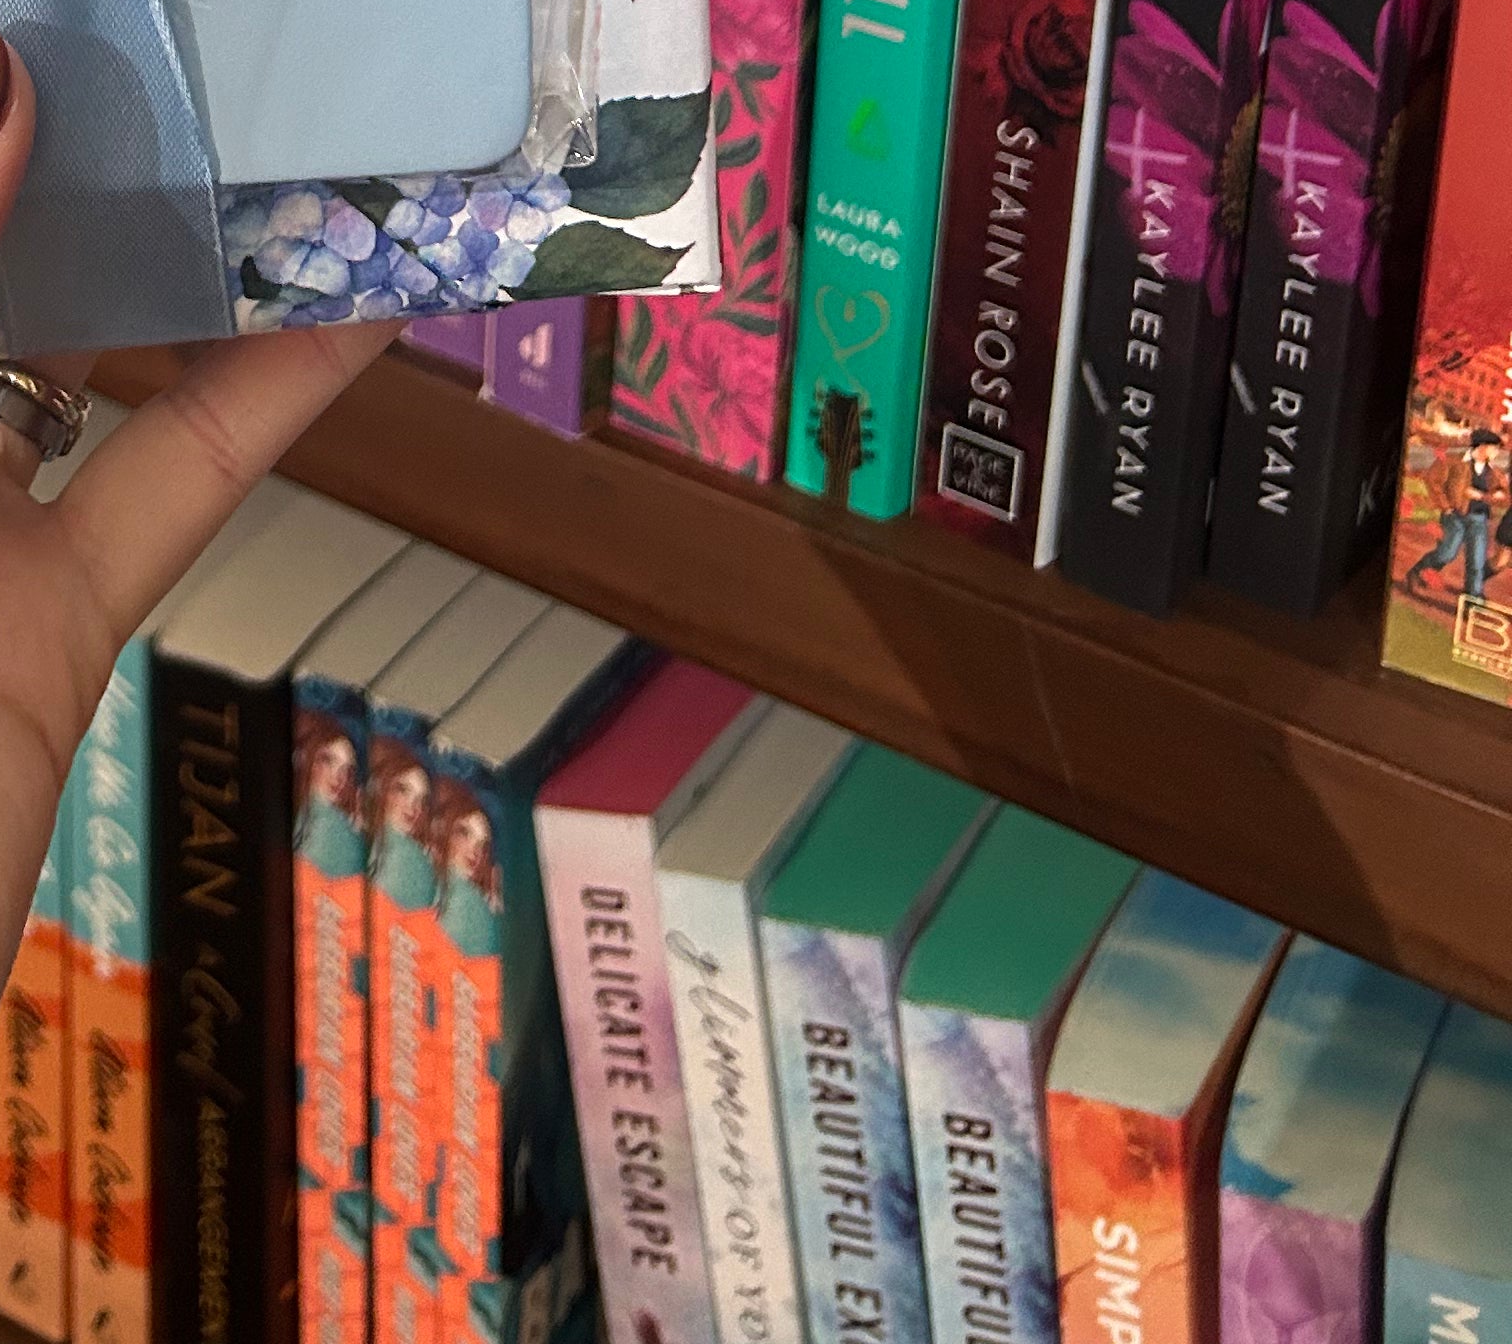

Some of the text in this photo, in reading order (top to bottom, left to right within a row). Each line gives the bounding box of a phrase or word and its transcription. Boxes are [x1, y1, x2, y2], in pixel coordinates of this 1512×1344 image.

[814, 226, 901, 271] WOOD
[816, 193, 902, 239] LAURA
[966, 119, 1041, 432] SHAIN ROSE
[1111, 179, 1176, 515] KAYLEE RYAN
[1258, 179, 1328, 514] KAYLEE RYAN
[178, 703, 240, 916] TIJAN
[580, 886, 679, 1275] DELICATE ESCAPE
[802, 1022, 883, 1344] BEAUTIFUL EX
[724, 1205, 761, 1271] OF
